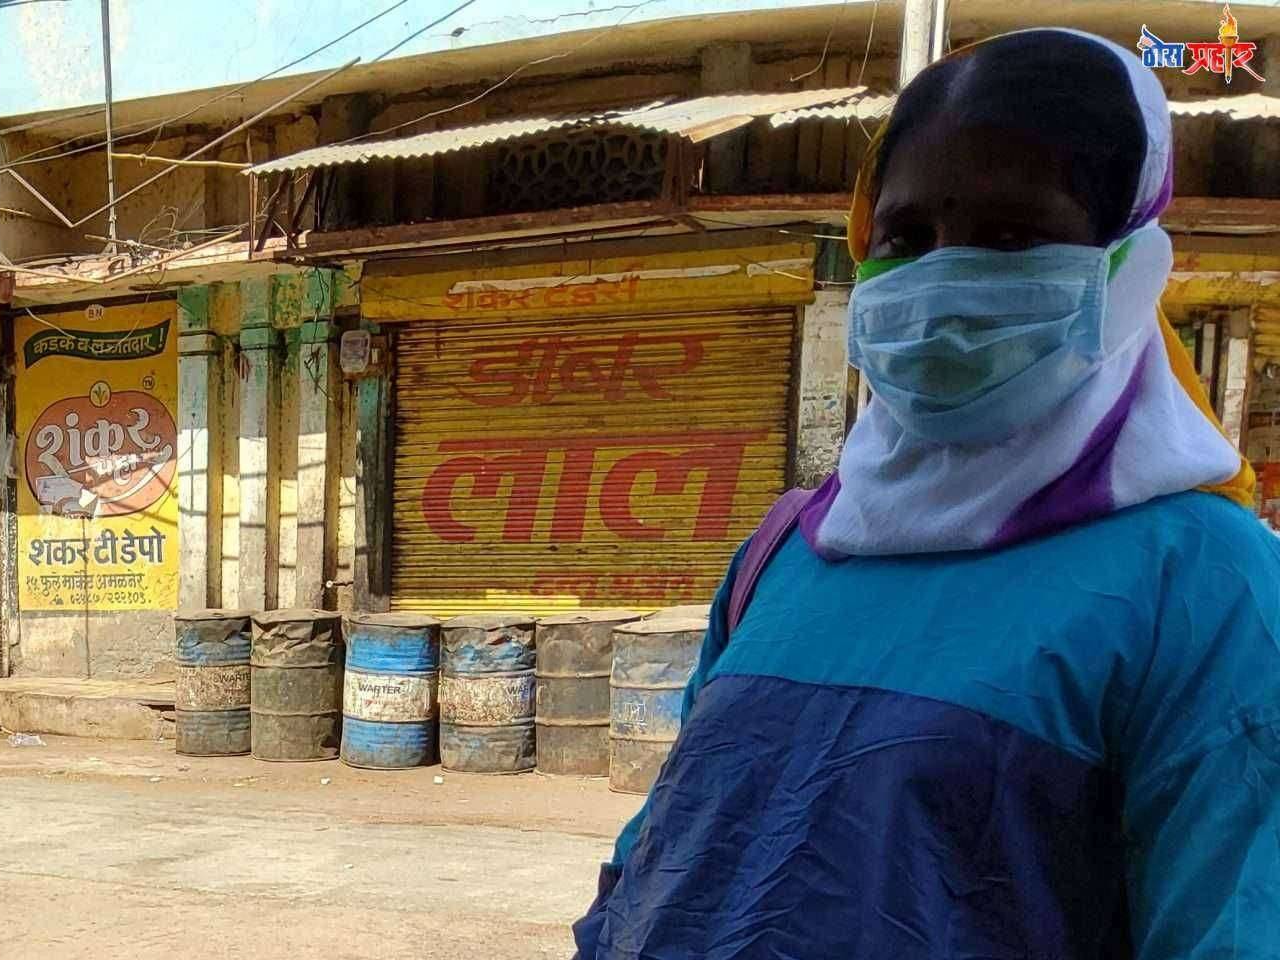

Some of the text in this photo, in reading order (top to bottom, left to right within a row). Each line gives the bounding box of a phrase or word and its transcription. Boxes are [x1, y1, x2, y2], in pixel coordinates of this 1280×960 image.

[33, 336, 75, 354] कडक
[36, 408, 162, 479] शंकर
[423, 430, 769, 543] लाल
[93, 528, 119, 565] टी
[120, 525, 166, 564] डेपो
[358, 682, 402, 696] WARTER
